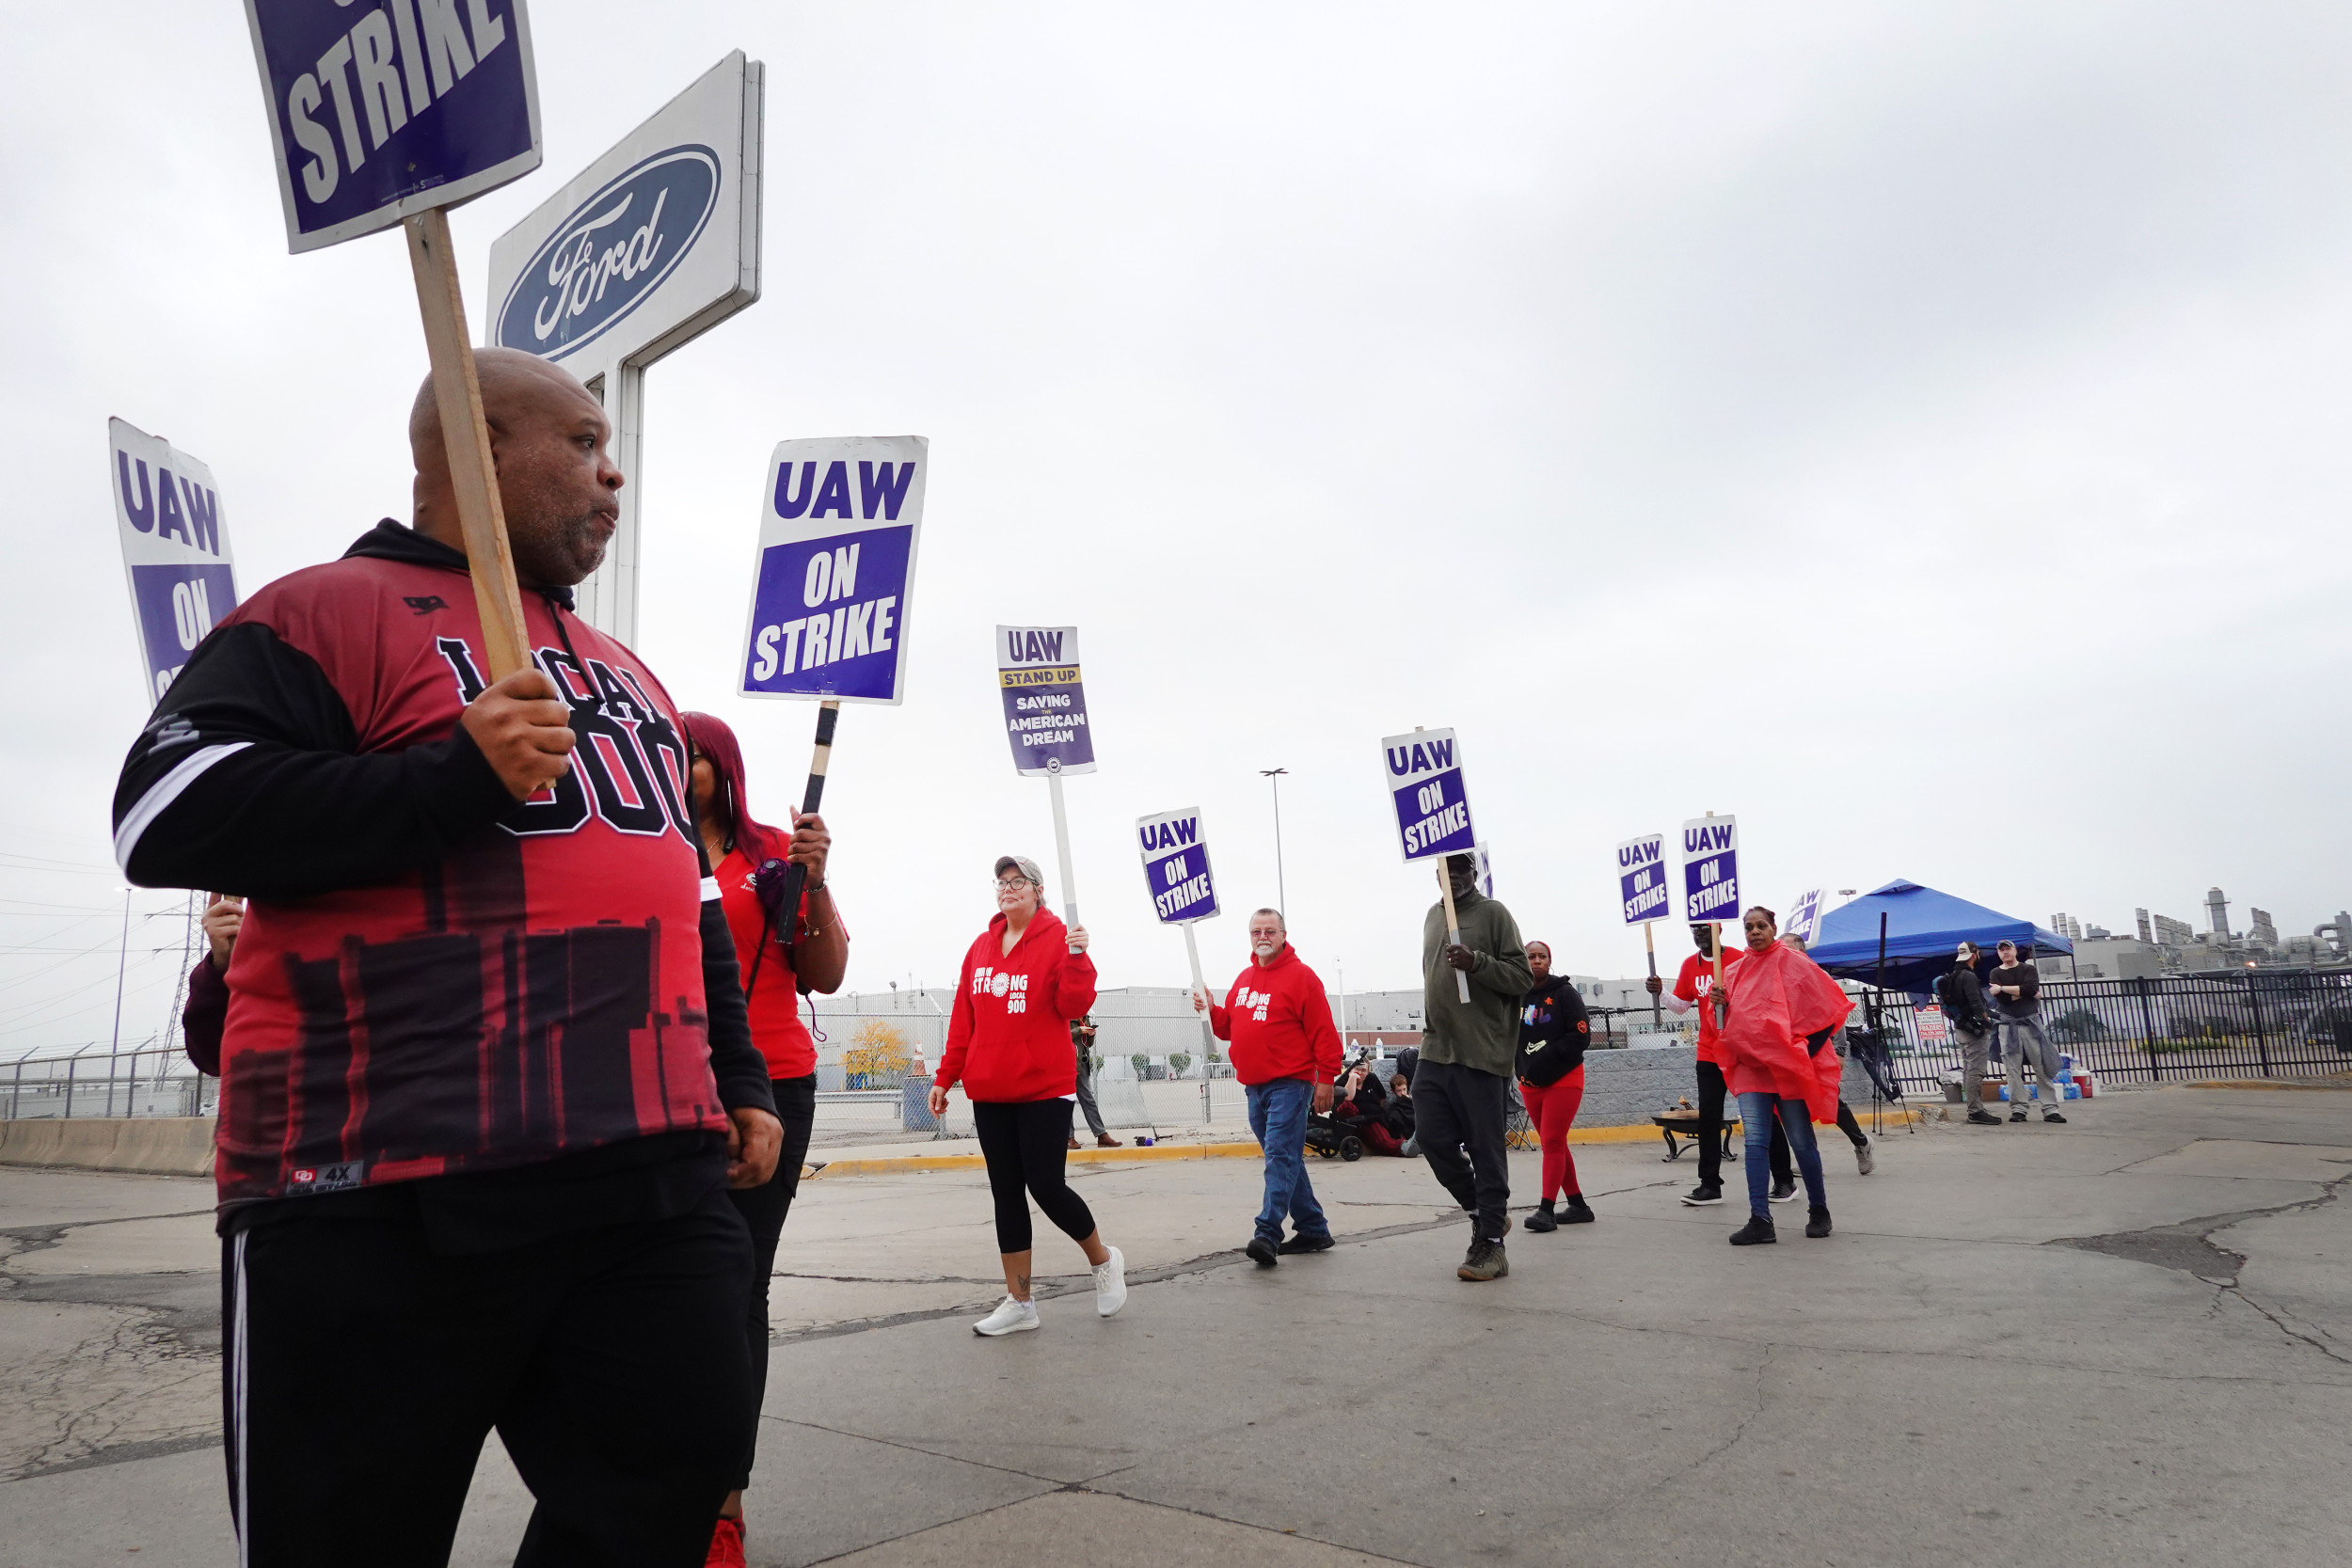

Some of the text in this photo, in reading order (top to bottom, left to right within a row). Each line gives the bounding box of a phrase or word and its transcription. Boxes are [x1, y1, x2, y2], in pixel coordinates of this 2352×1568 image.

[534, 189, 668, 341] Ford
[118, 449, 220, 557] UAW
[773, 461, 916, 521] UAW
[803, 543, 861, 609] ON
[172, 578, 213, 651] ON
[753, 595, 897, 682] STRIKE
[1008, 630, 1063, 662] UAW
[1004, 670, 1076, 685] STAND UP
[1016, 694, 1071, 710] SAVING
[1009, 712, 1086, 732] AMERICAN
[1022, 730, 1074, 747] DREAM
[1387, 737, 1453, 776] UAW
[1417, 780, 1445, 816] ON
[1139, 816, 1197, 851] UAW
[1404, 800, 1469, 854] STRIKE
[1684, 824, 1732, 853] UAW
[1618, 840, 1661, 867] UAW
[1165, 854, 1188, 886] ON
[1633, 869, 1651, 894] ON
[1700, 859, 1720, 887] ON
[1155, 872, 1211, 918] STRIKE
[1625, 882, 1666, 920] STRIKE
[1689, 878, 1737, 917] STRIKE
[1007, 999, 1026, 1015] 900
[1009, 991, 1026, 1000] LOCAL
[1252, 1010, 1267, 1022] 900
[324, 1165, 352, 1181] 4X
